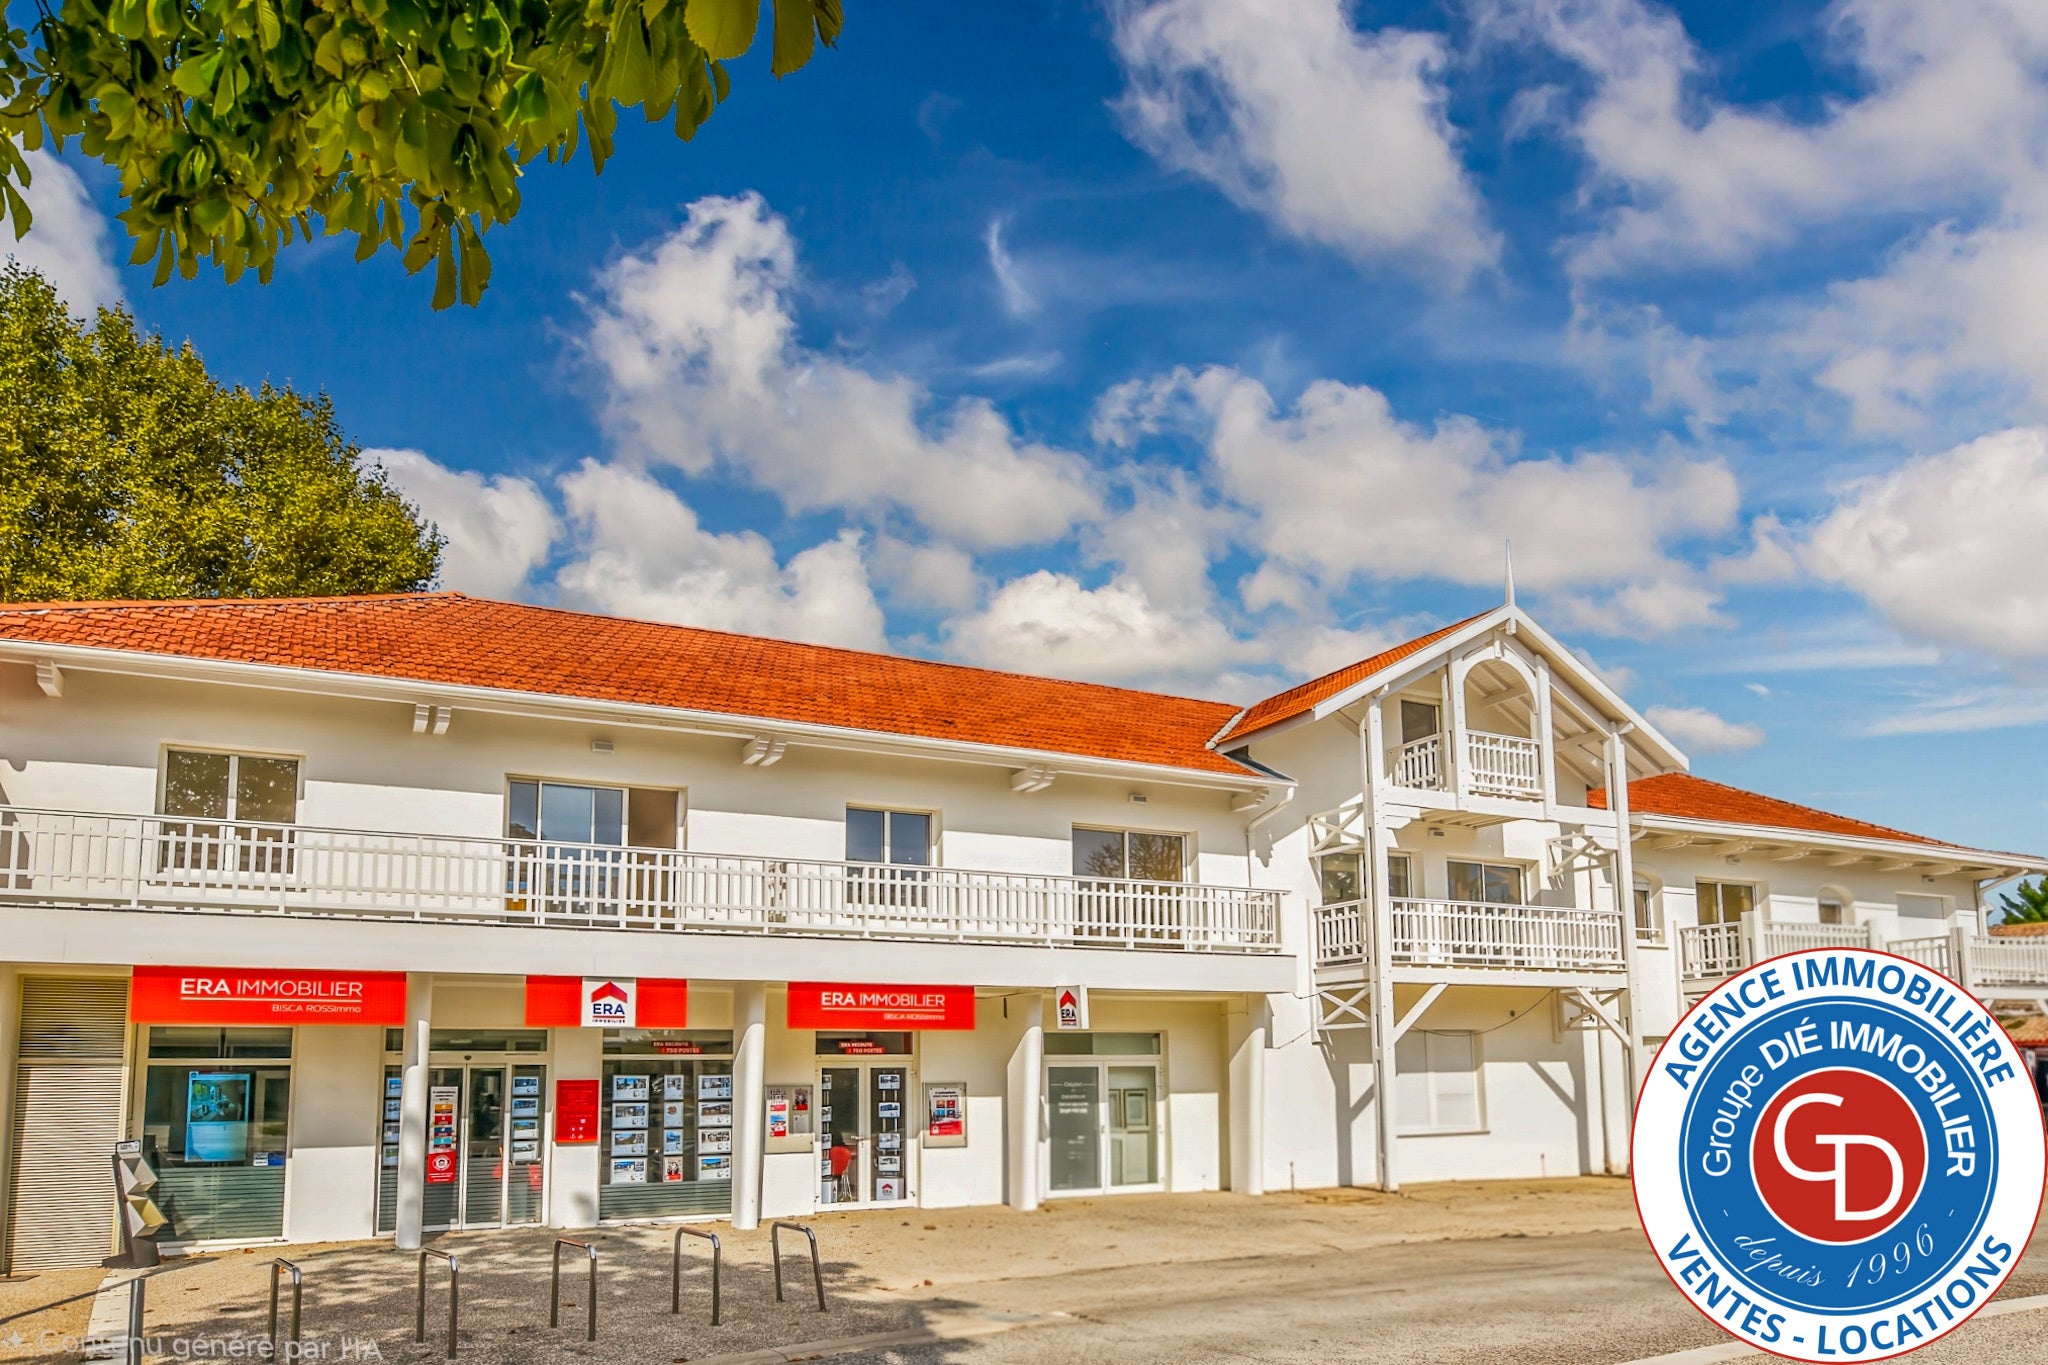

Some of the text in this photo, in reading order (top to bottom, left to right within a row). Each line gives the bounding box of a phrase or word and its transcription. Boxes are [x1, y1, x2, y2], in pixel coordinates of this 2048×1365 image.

[180, 978, 363, 997] ERA IMMOBILIER
[821, 992, 946, 1007] ERA IMMOBILIER
[272, 1004, 303, 1012] BISCA
[593, 1003, 625, 1014] ERA
[1061, 1009, 1077, 1019] ERA
